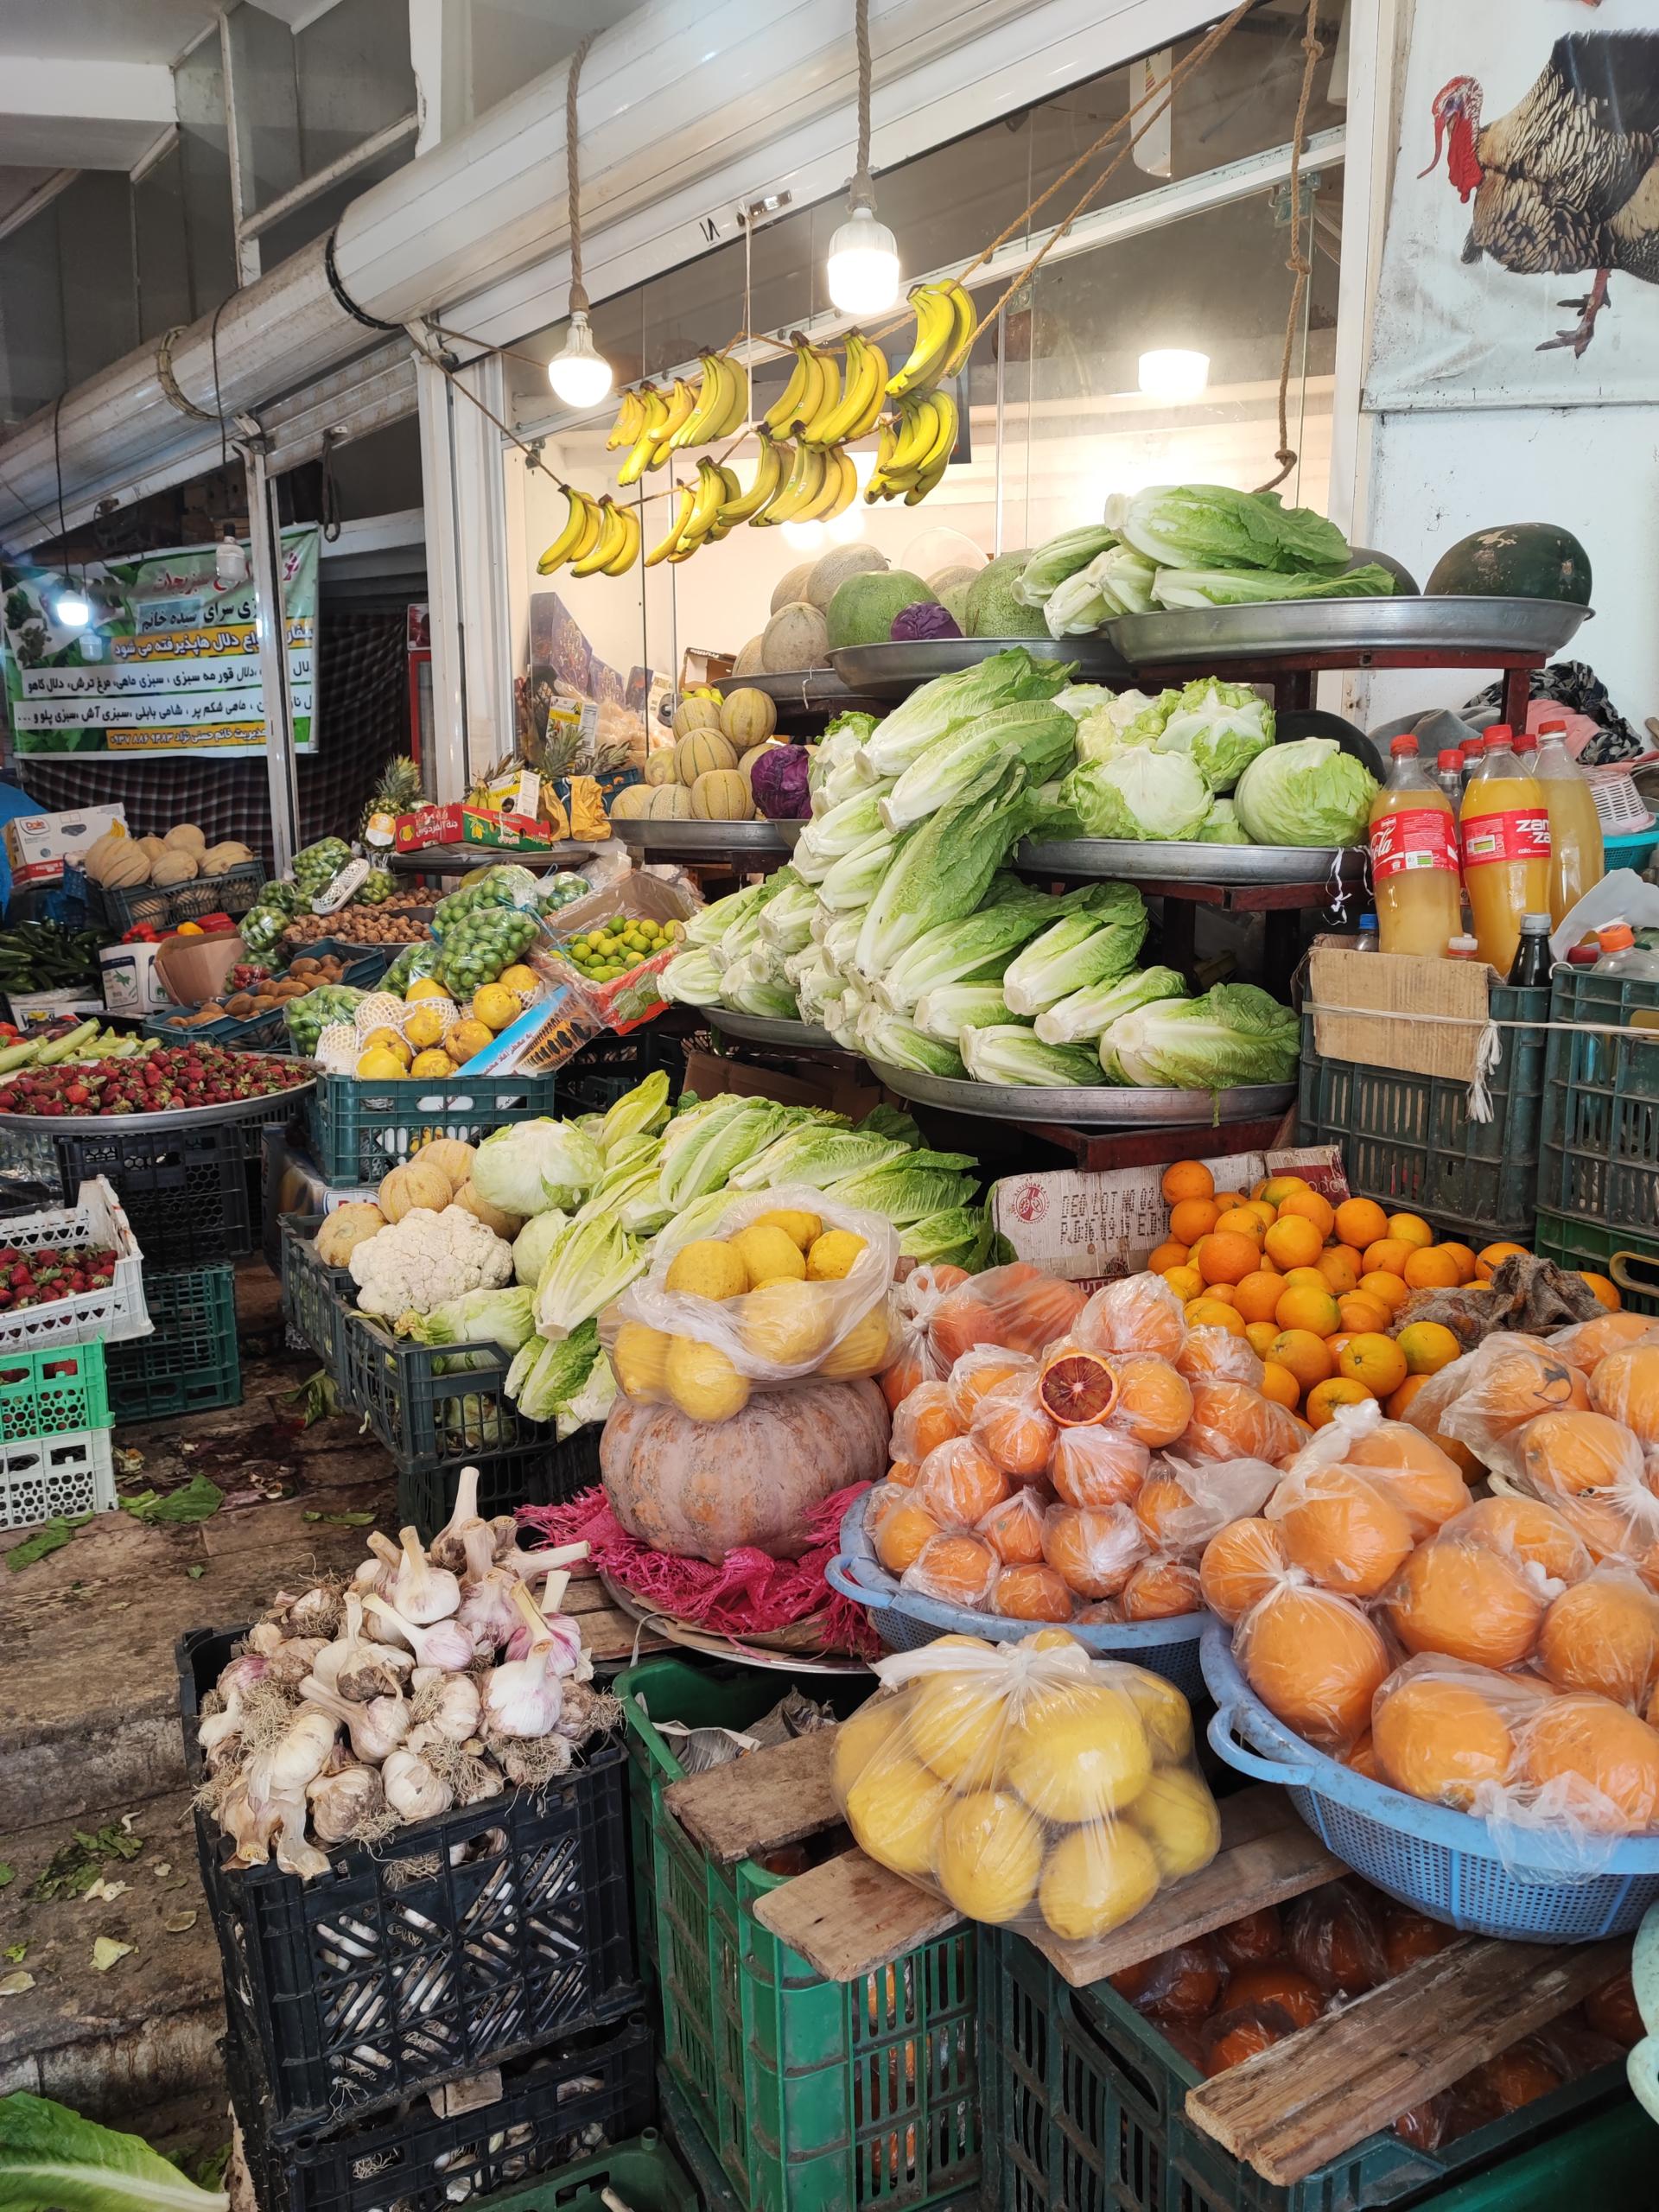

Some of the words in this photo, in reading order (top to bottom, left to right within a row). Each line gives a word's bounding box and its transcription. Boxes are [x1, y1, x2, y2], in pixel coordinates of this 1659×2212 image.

[169, 609, 197, 628] سیده
[203, 601, 234, 623] سرای
[141, 610, 168, 632] خانم
[137, 642, 152, 657] می
[213, 633, 239, 652] دلال
[115, 643, 137, 658] شود
[292, 660, 311, 677] لال
[46, 677, 64, 692] دلال
[96, 677, 111, 694] مرغ
[139, 673, 164, 688] سبزی
[173, 671, 200, 686] سبزی
[81, 706, 100, 721] آش
[135, 706, 156, 721] بابلی
[158, 704, 183, 719] شامی
[203, 702, 223, 716] شکم
[226, 700, 246, 715] ماهی
[1533, 831, 1552, 843] za
